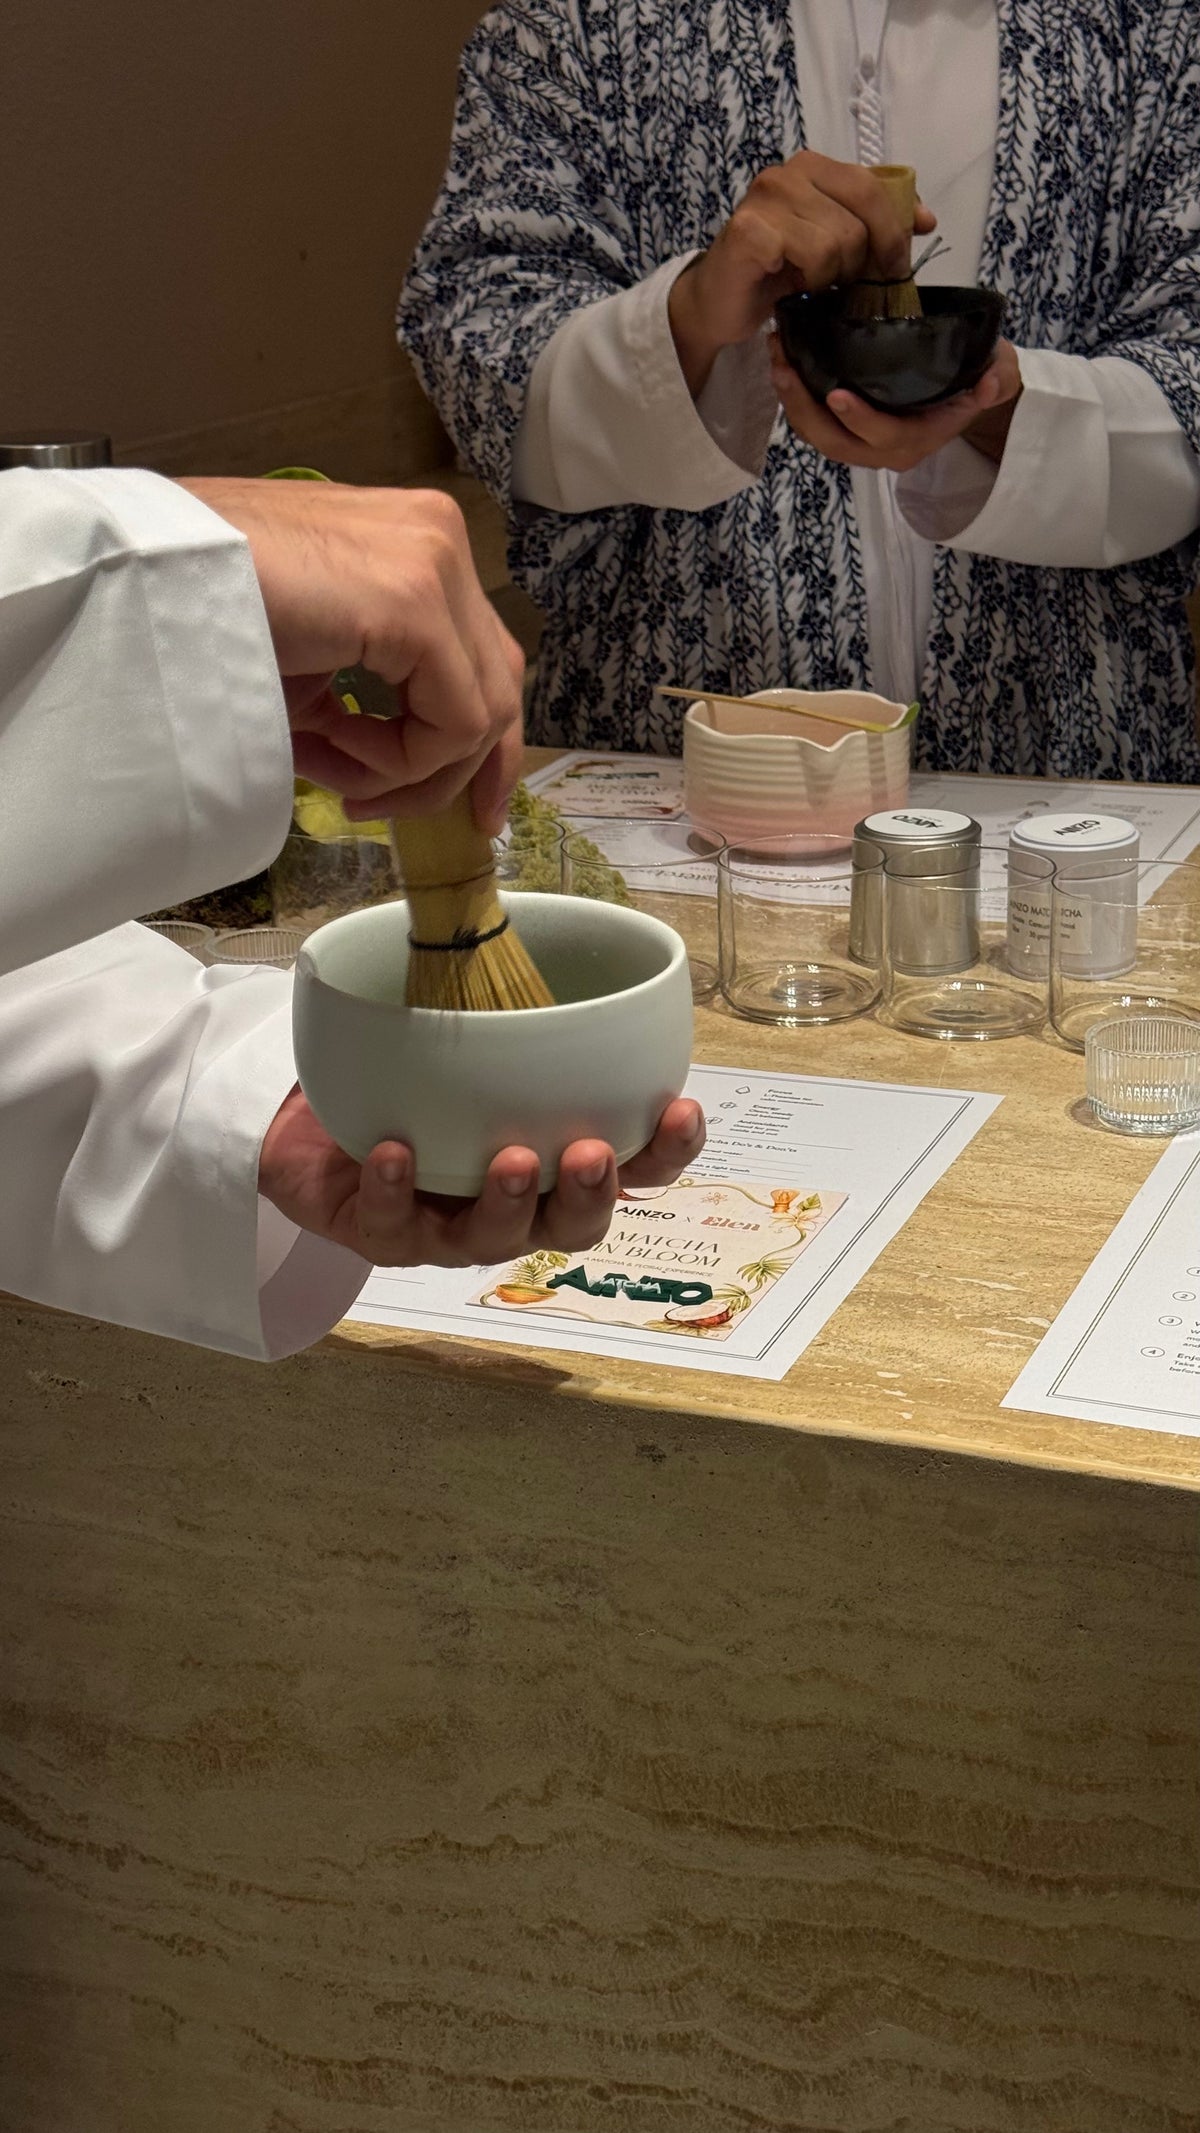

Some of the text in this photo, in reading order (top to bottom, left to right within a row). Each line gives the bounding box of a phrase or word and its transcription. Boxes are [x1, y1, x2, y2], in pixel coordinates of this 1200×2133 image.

[615, 1206, 676, 1220] AINZO
[613, 1231, 719, 1253] MATCHA
[592, 1242, 721, 1268] IN BLOOM
[591, 1257, 625, 1267] MATCHA
[663, 1267, 715, 1278] EXPERIENCE
